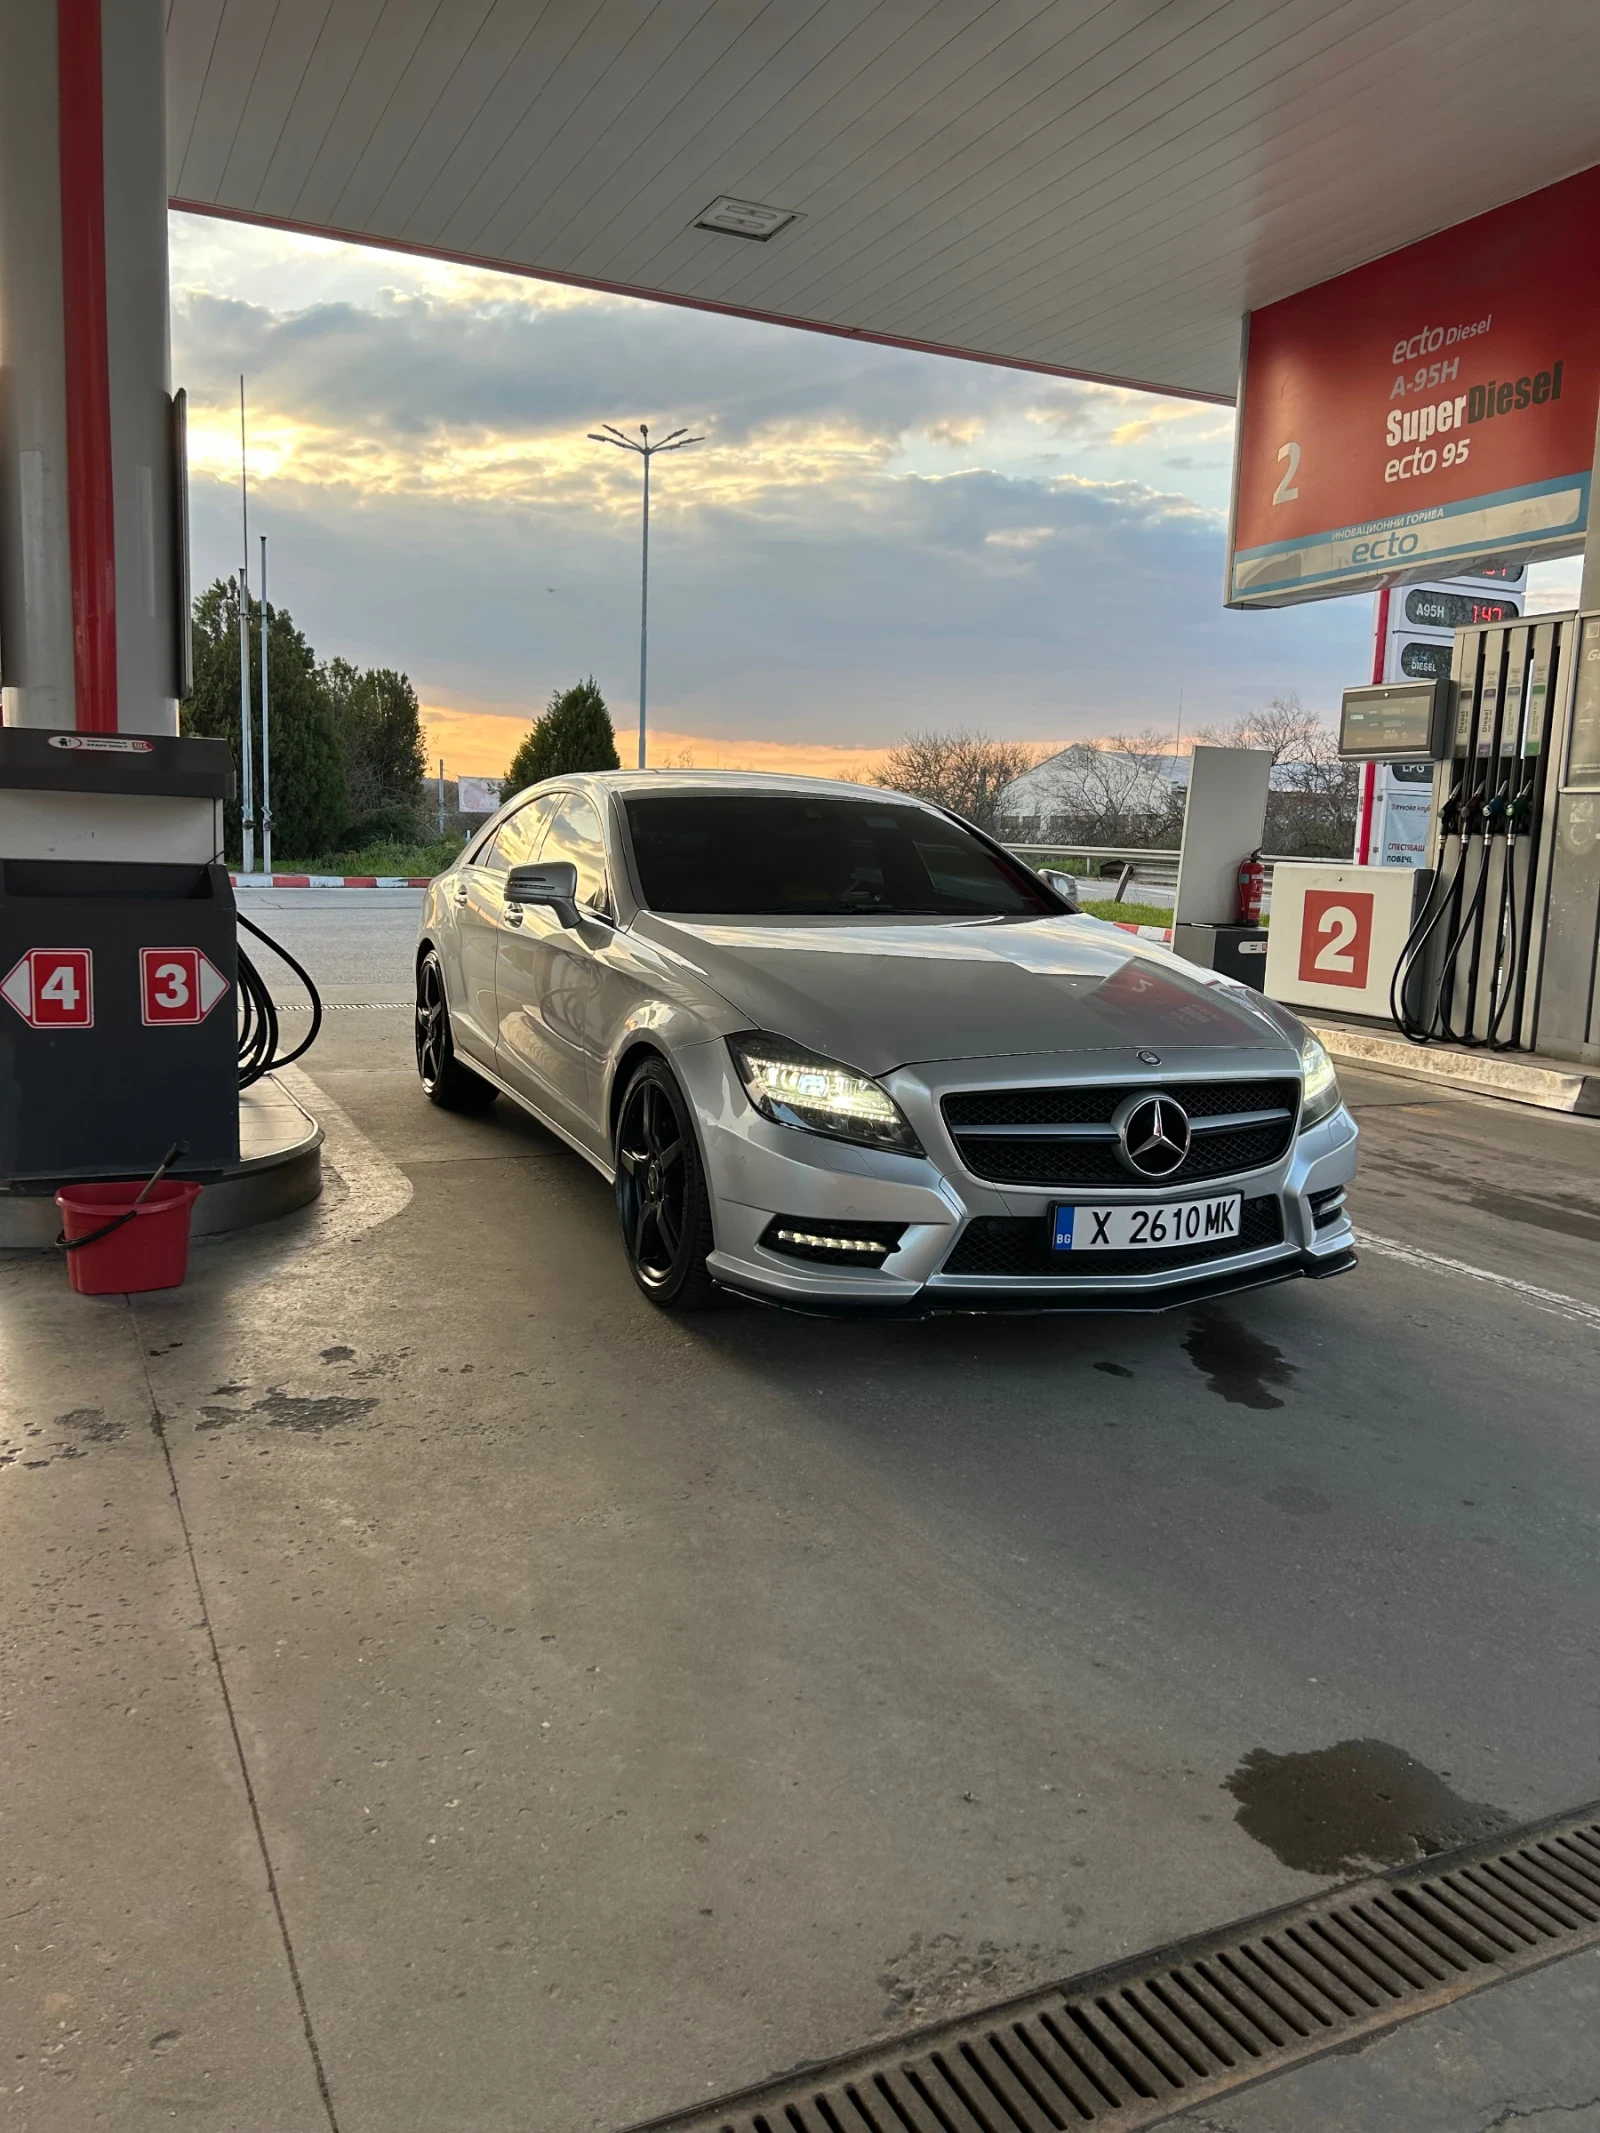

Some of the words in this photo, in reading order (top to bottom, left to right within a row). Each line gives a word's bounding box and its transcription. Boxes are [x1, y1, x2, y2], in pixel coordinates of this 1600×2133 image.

[1392, 325, 1443, 365] ecto
[1445, 314, 1492, 346] Diesel
[1272, 441, 1301, 506] 2
[1385, 446, 1438, 483] ecto
[1441, 438, 1470, 468] 95
[1331, 518, 1404, 541] ИНОВАЦИОННИ
[1406, 508, 1444, 525] ГОРИВА
[1352, 531, 1419, 564] ecto
[1411, 661, 1436, 672] DIESEL
[1314, 905, 1358, 973] 2
[41, 966, 80, 1010] 4
[154, 963, 190, 1009] 3
[1056, 1234, 1071, 1244] BG
